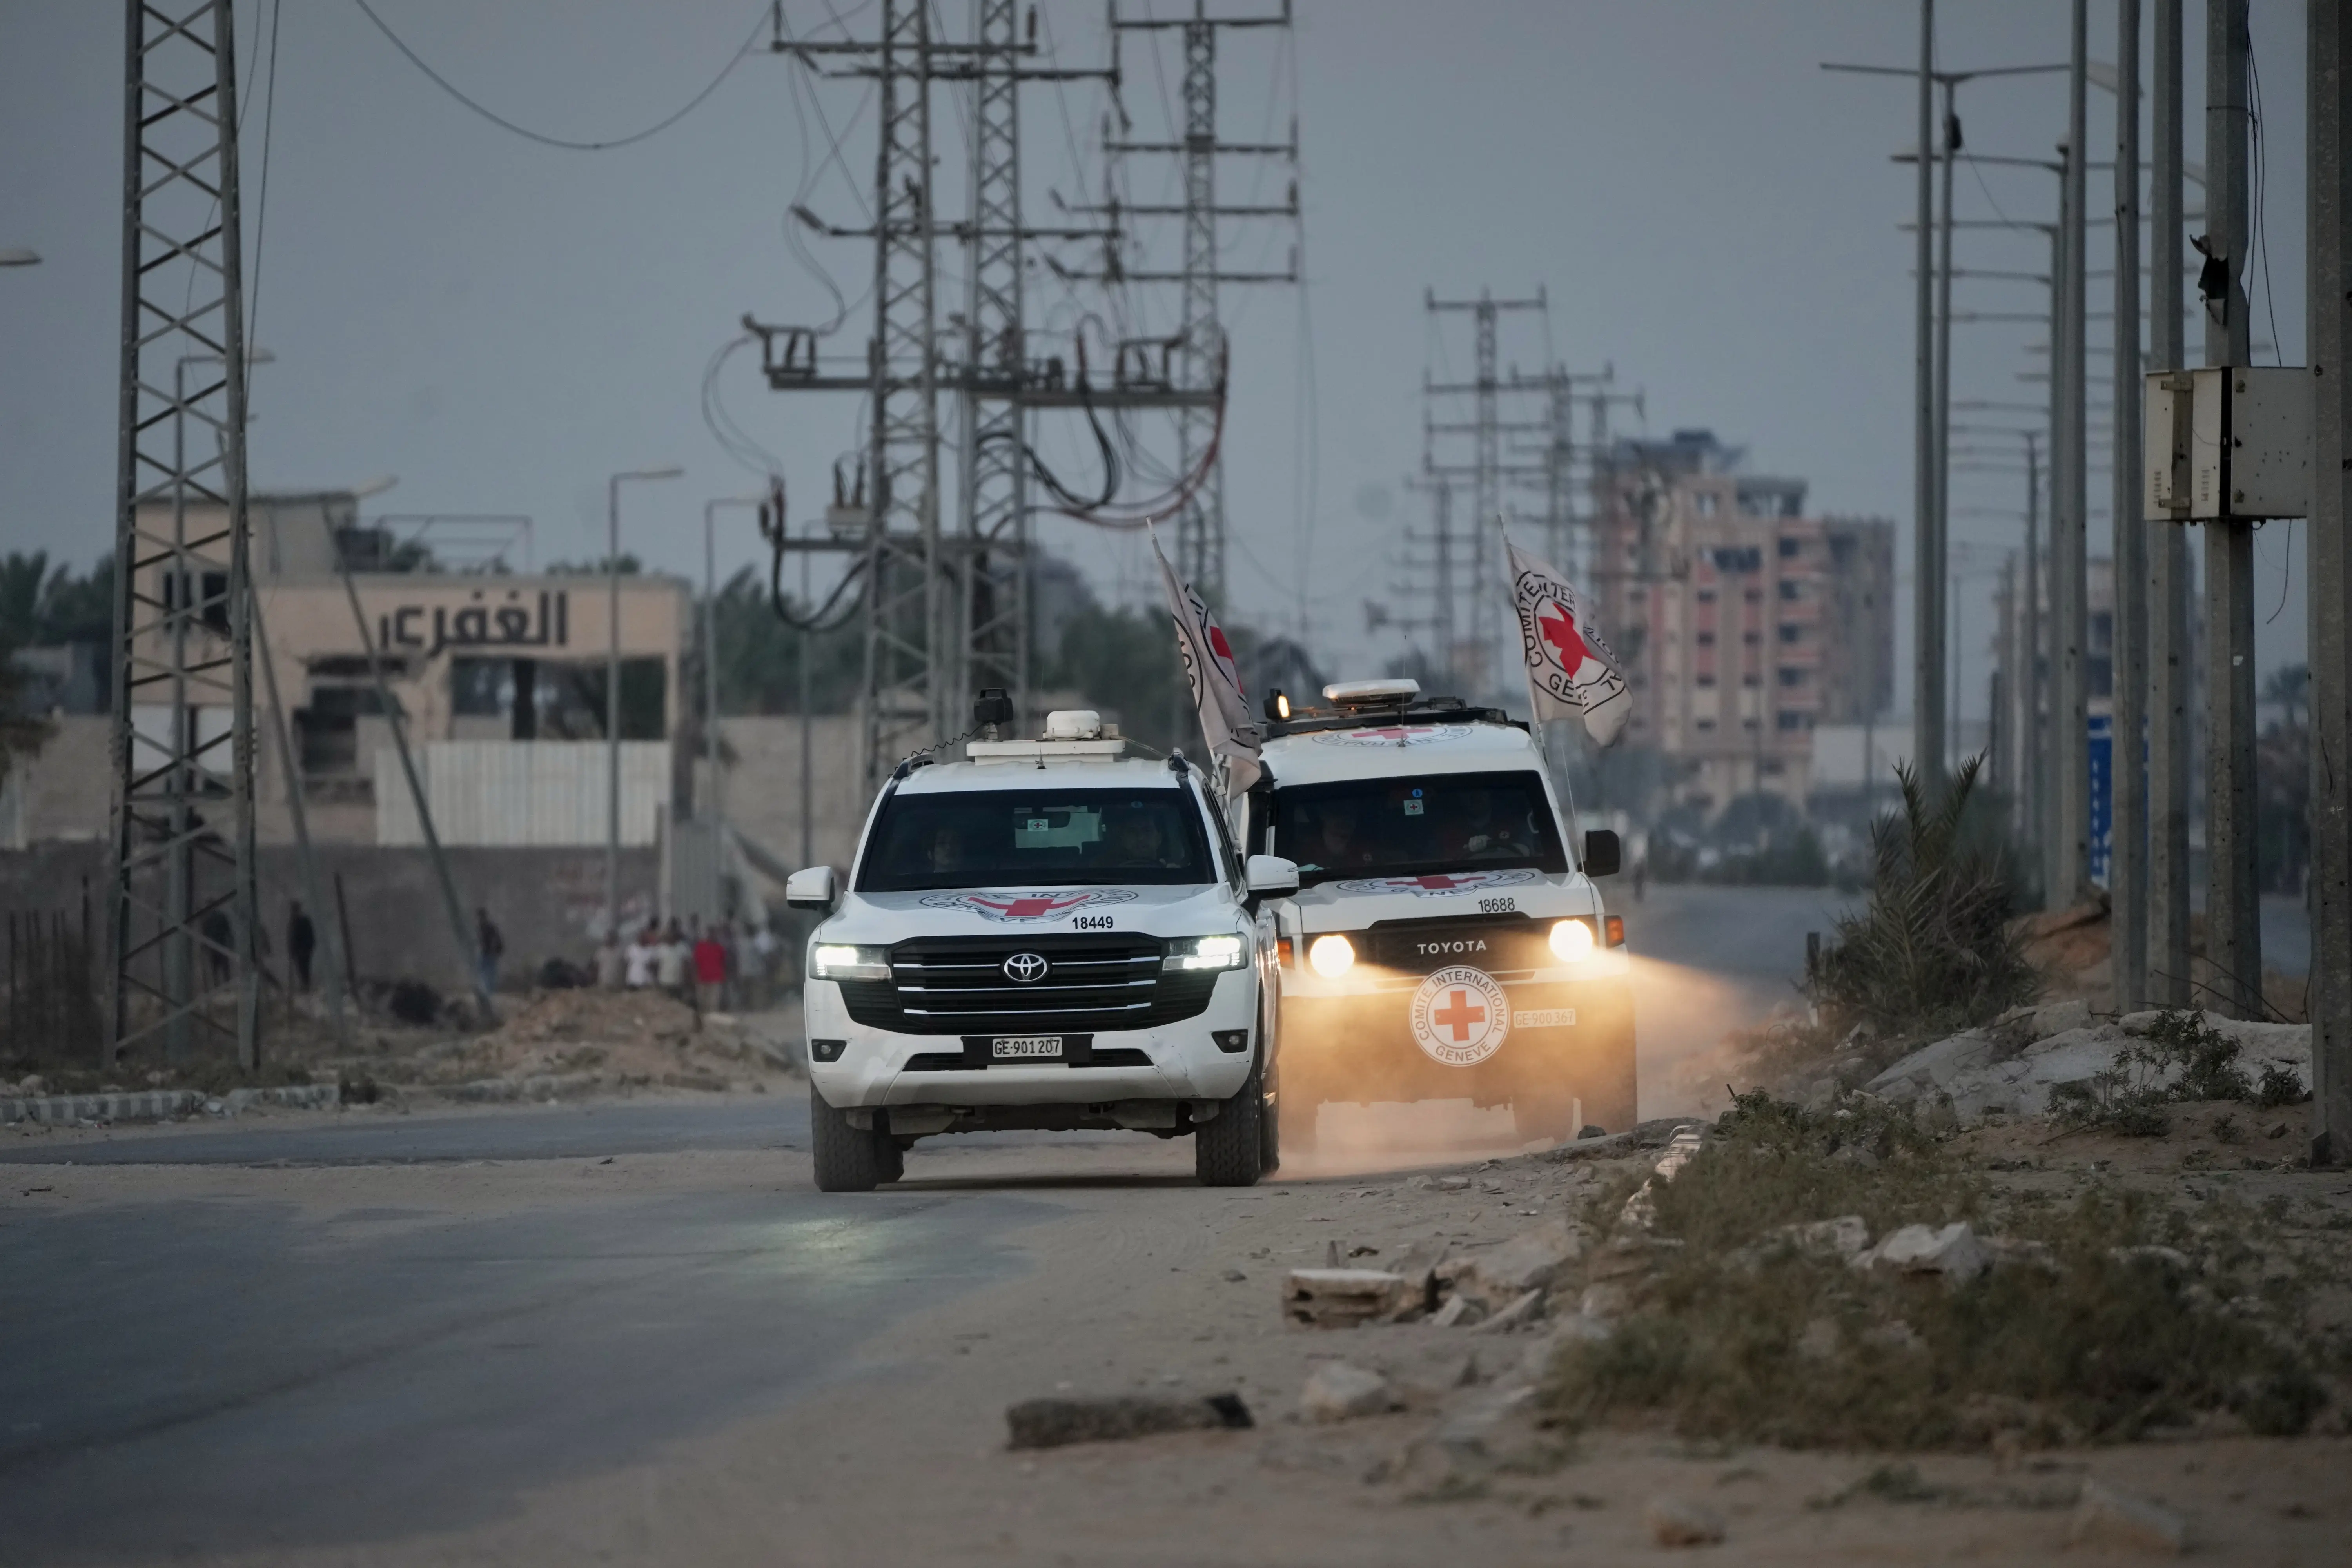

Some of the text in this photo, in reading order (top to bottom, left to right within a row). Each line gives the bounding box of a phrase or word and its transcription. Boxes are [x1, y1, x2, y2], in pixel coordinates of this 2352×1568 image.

[1478, 897, 1515, 913] 18688
[1072, 916, 1114, 929] 18449
[1417, 940, 1487, 955] TOYOTA
[1414, 971, 1505, 1041] COMITE INTERNATIONAL
[1435, 1041, 1491, 1062] GENEVE
